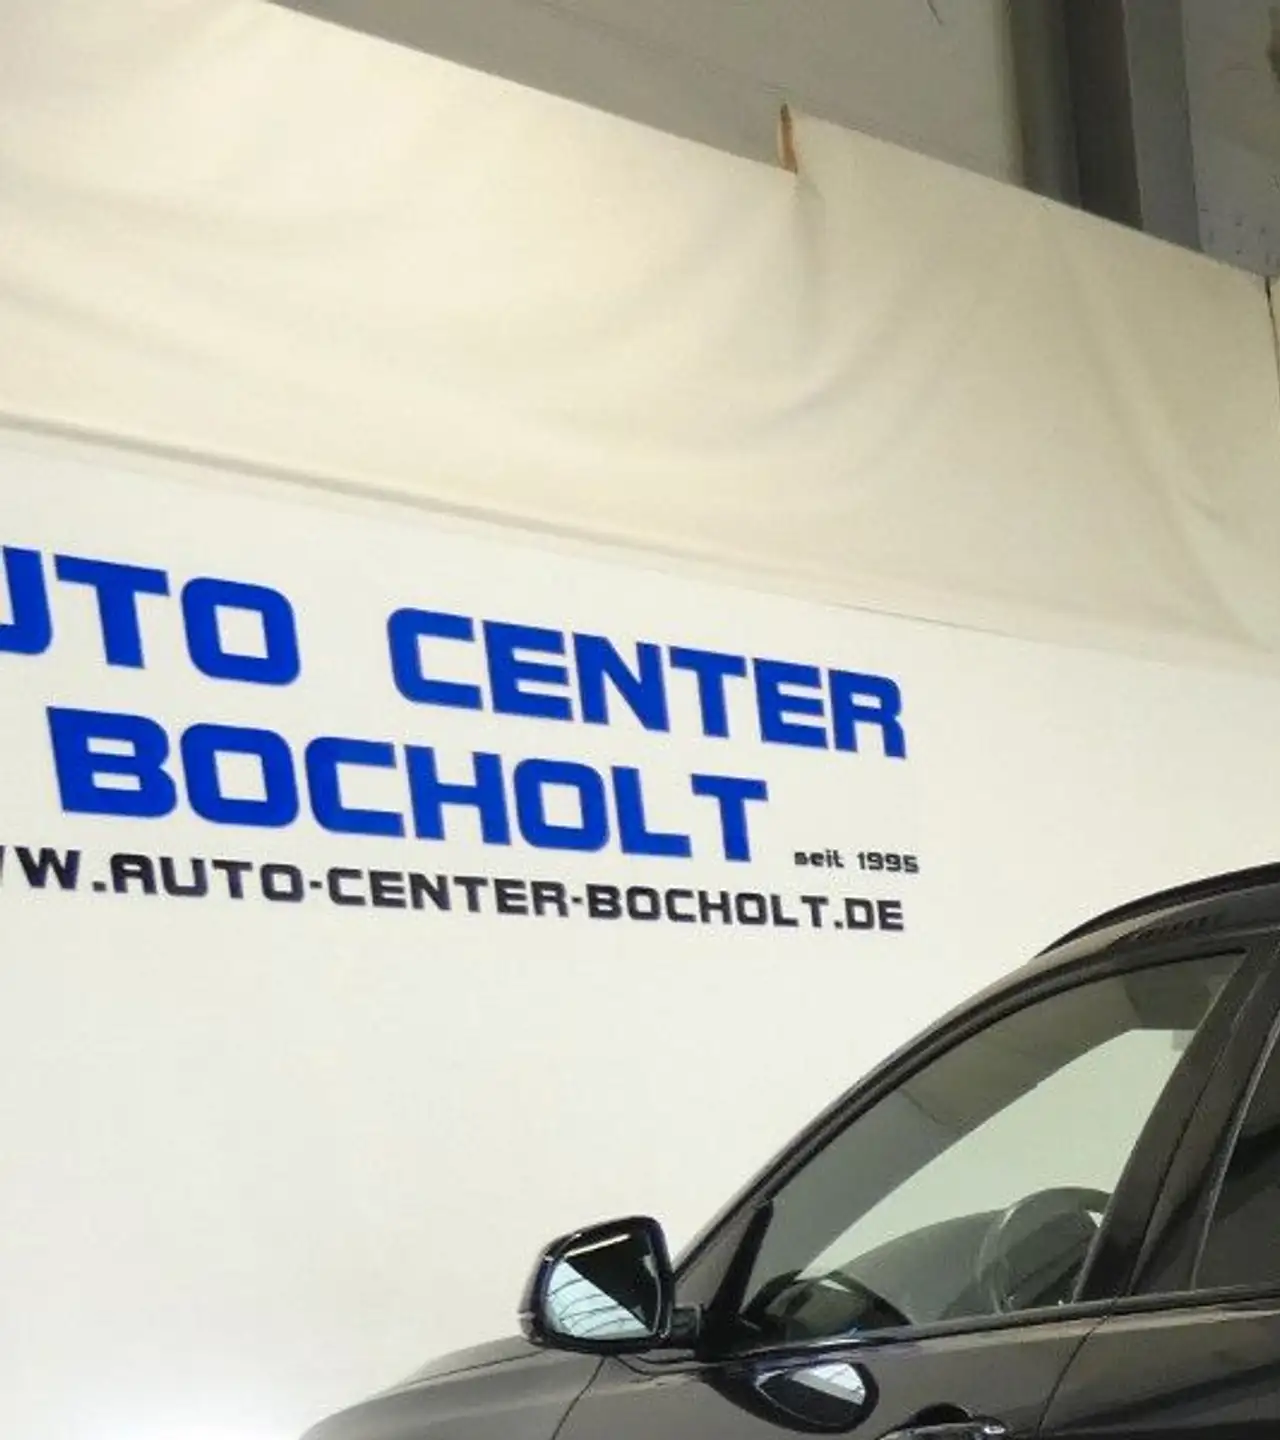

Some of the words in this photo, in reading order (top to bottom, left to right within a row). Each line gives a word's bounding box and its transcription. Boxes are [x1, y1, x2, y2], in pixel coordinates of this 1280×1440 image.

[388, 607, 907, 759] CENTER
[48, 706, 769, 861] BOCHOLT
[0, 845, 905, 931] W.AUTO-CENTER-BOCHOLT.DE
[794, 850, 845, 869] seit
[857, 852, 919, 873] 1995
